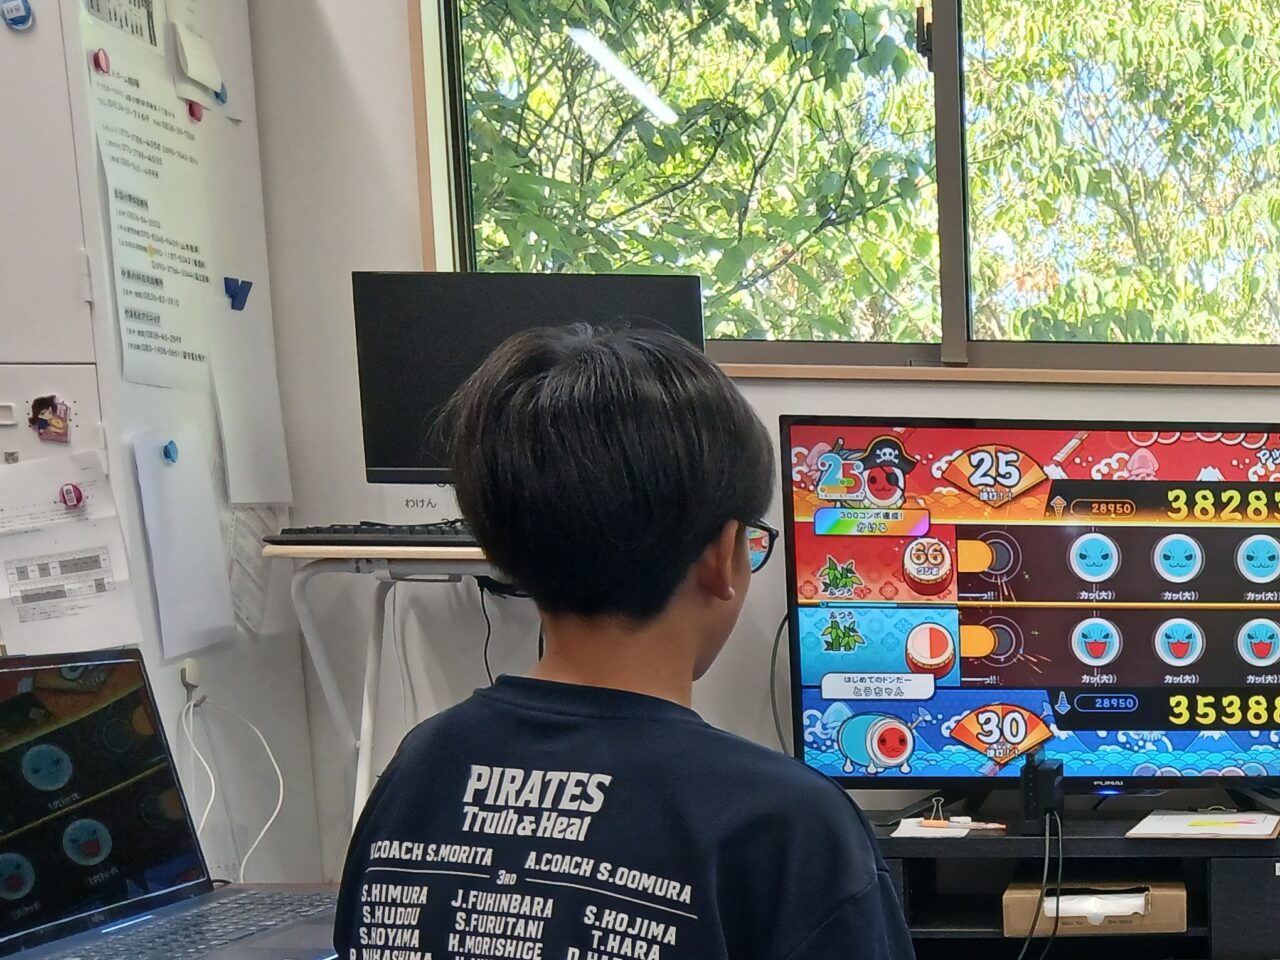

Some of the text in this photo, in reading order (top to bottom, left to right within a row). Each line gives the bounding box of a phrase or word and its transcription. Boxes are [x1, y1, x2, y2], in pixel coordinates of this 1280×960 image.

[968, 452, 1021, 487] 25
[405, 498, 437, 508] わけん
[1091, 503, 1131, 514] 28950
[909, 543, 944, 565] 66
[916, 567, 939, 575] コンボ
[853, 686, 904, 697] とうちゃん
[1095, 698, 1133, 708] 28950
[976, 711, 1027, 744] 30
[462, 765, 613, 813] PIRATES
[426, 844, 493, 866] S.MORITA
[524, 850, 692, 904] A.COACH S.OOMURA
[454, 911, 545, 939] S.FURUTANI
[447, 933, 544, 960] H.MORISHIGE
